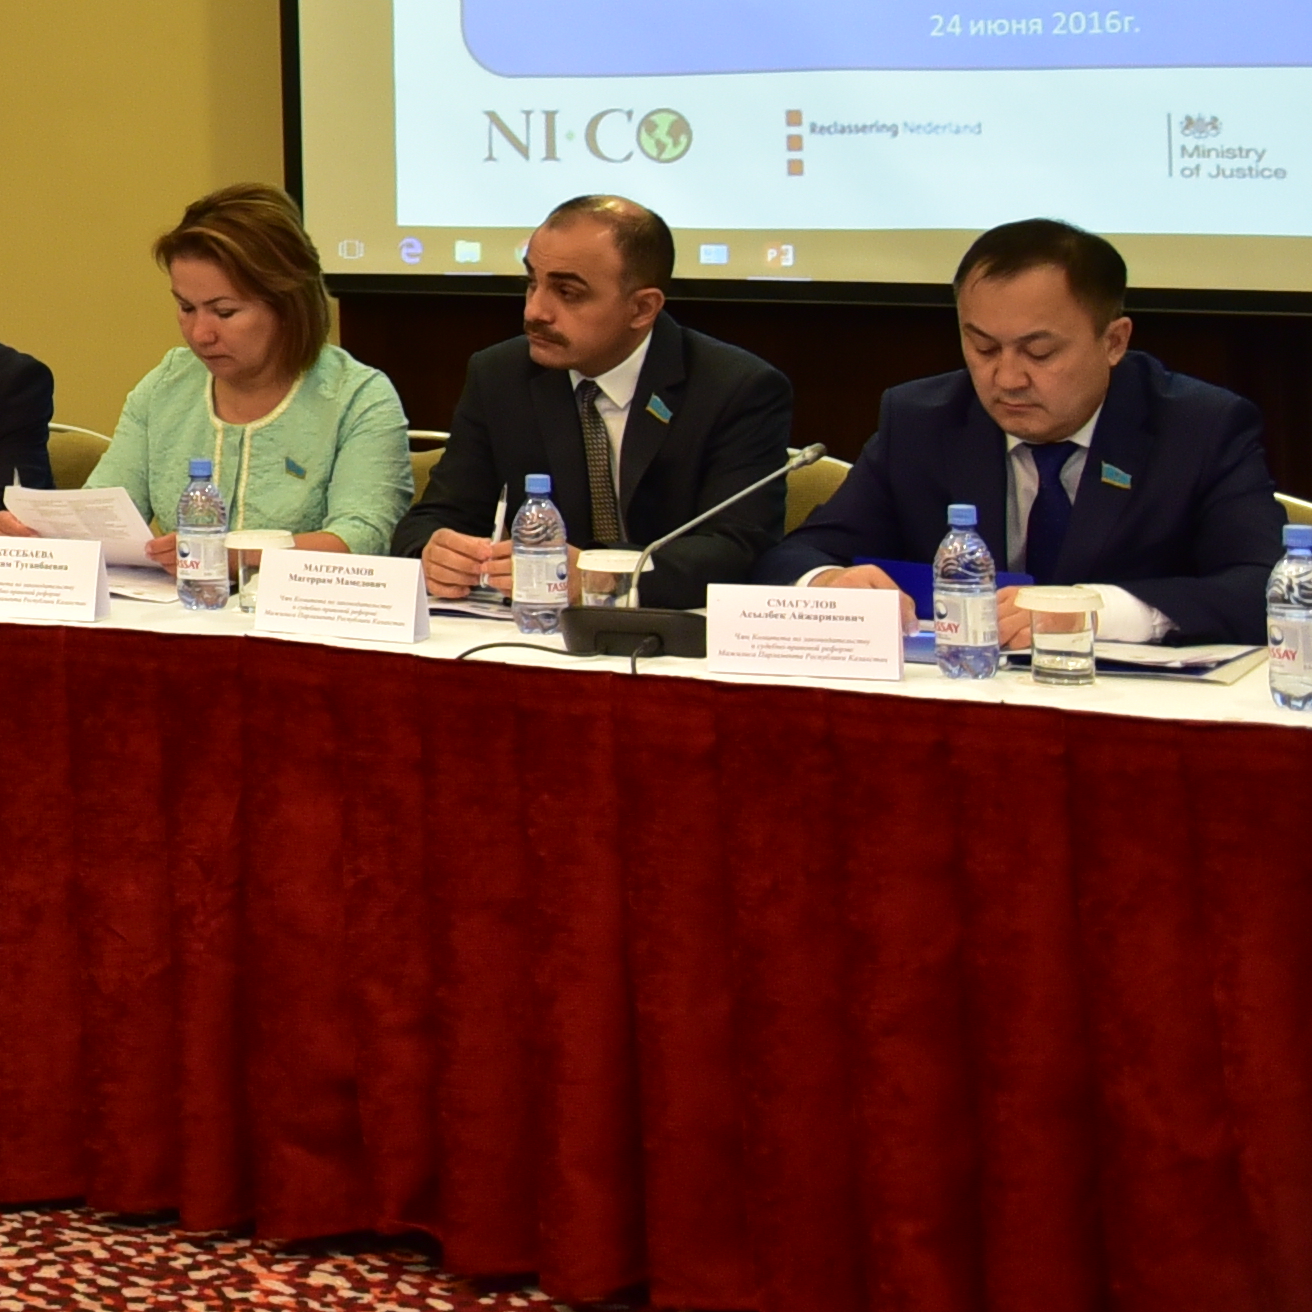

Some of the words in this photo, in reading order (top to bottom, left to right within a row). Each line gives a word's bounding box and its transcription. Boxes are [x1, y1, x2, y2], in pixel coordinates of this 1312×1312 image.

[930, 14, 962, 37] 24
[970, 13, 1043, 36] июня
[1052, 10, 1141, 35] 2016г.
[809, 121, 899, 138] Reclassering
[903, 120, 983, 136] Nederland
[1180, 144, 1267, 164] Ministry
[1180, 164, 1202, 179] of
[1208, 164, 1288, 180] Justice
[304, 563, 374, 576] МАГЕРРАМОВ
[289, 573, 333, 585] Магеррам
[767, 598, 837, 609] СМАГУЛОВ
[740, 610, 786, 620] Асылбек
